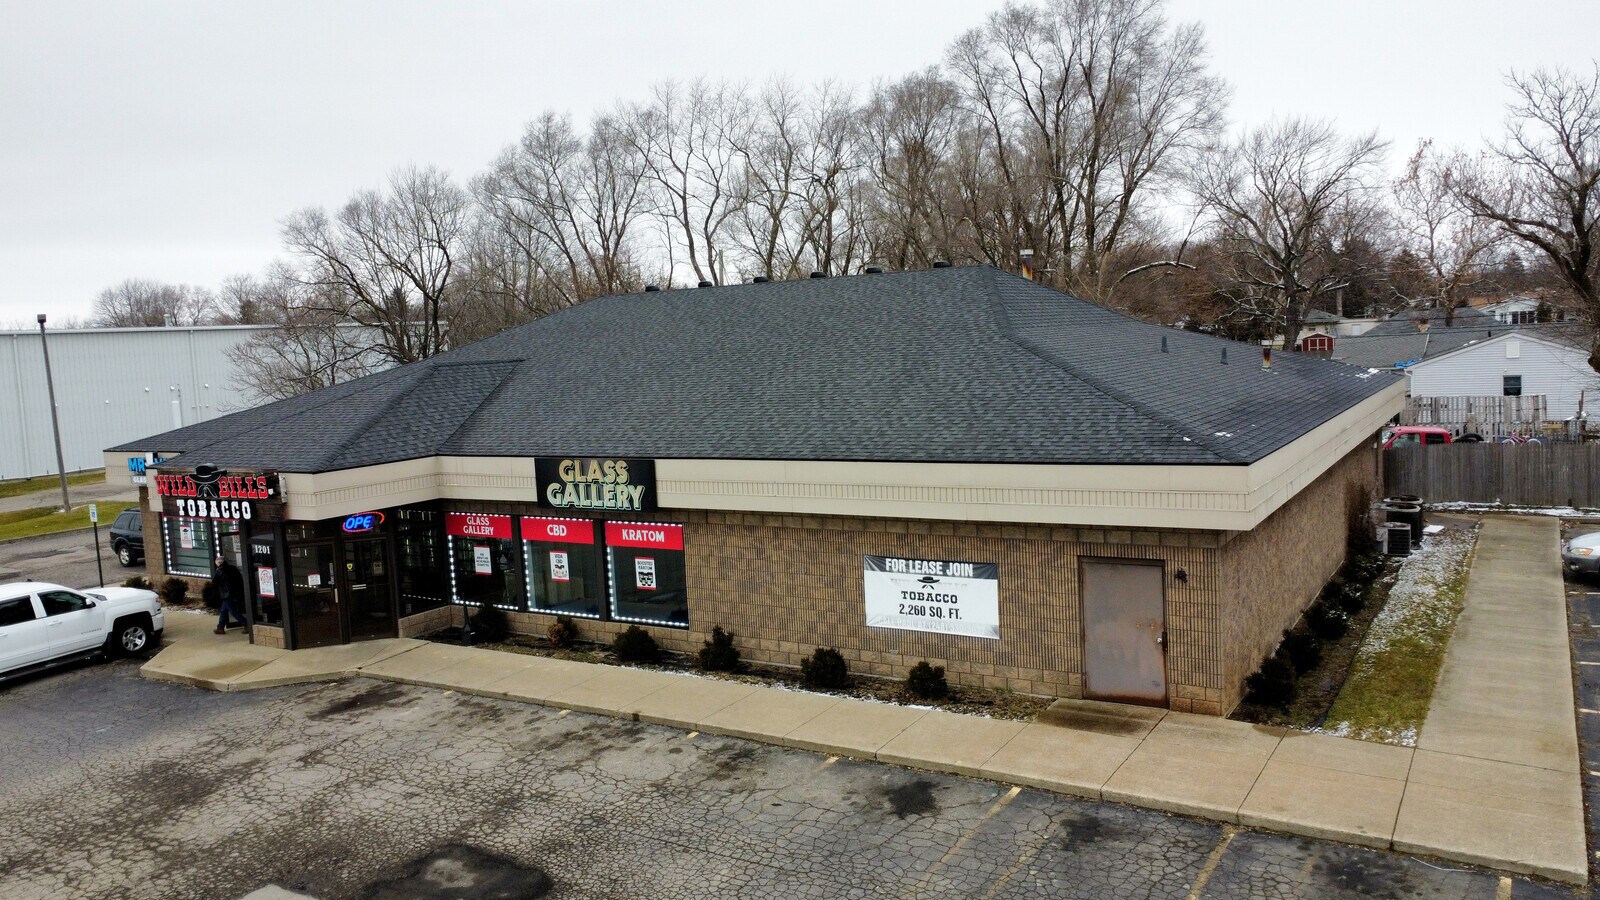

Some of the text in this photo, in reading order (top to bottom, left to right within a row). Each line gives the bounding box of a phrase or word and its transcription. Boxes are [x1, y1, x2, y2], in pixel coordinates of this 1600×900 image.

[559, 459, 629, 485] GLASS
[154, 474, 268, 499] WILD BILL'S
[546, 482, 646, 511] GALLERY
[176, 499, 251, 519] TOBACCO
[466, 516, 489, 526] GLASS
[463, 525, 494, 535] GALLERY
[546, 525, 567, 537] CBD
[622, 529, 665, 542] KRATOM
[255, 545, 271, 555] 1201
[885, 558, 973, 577] FOR LEASE JOIN
[901, 591, 958, 604] TOBACCO
[899, 603, 962, 620] 2,260 SQ. FT.
